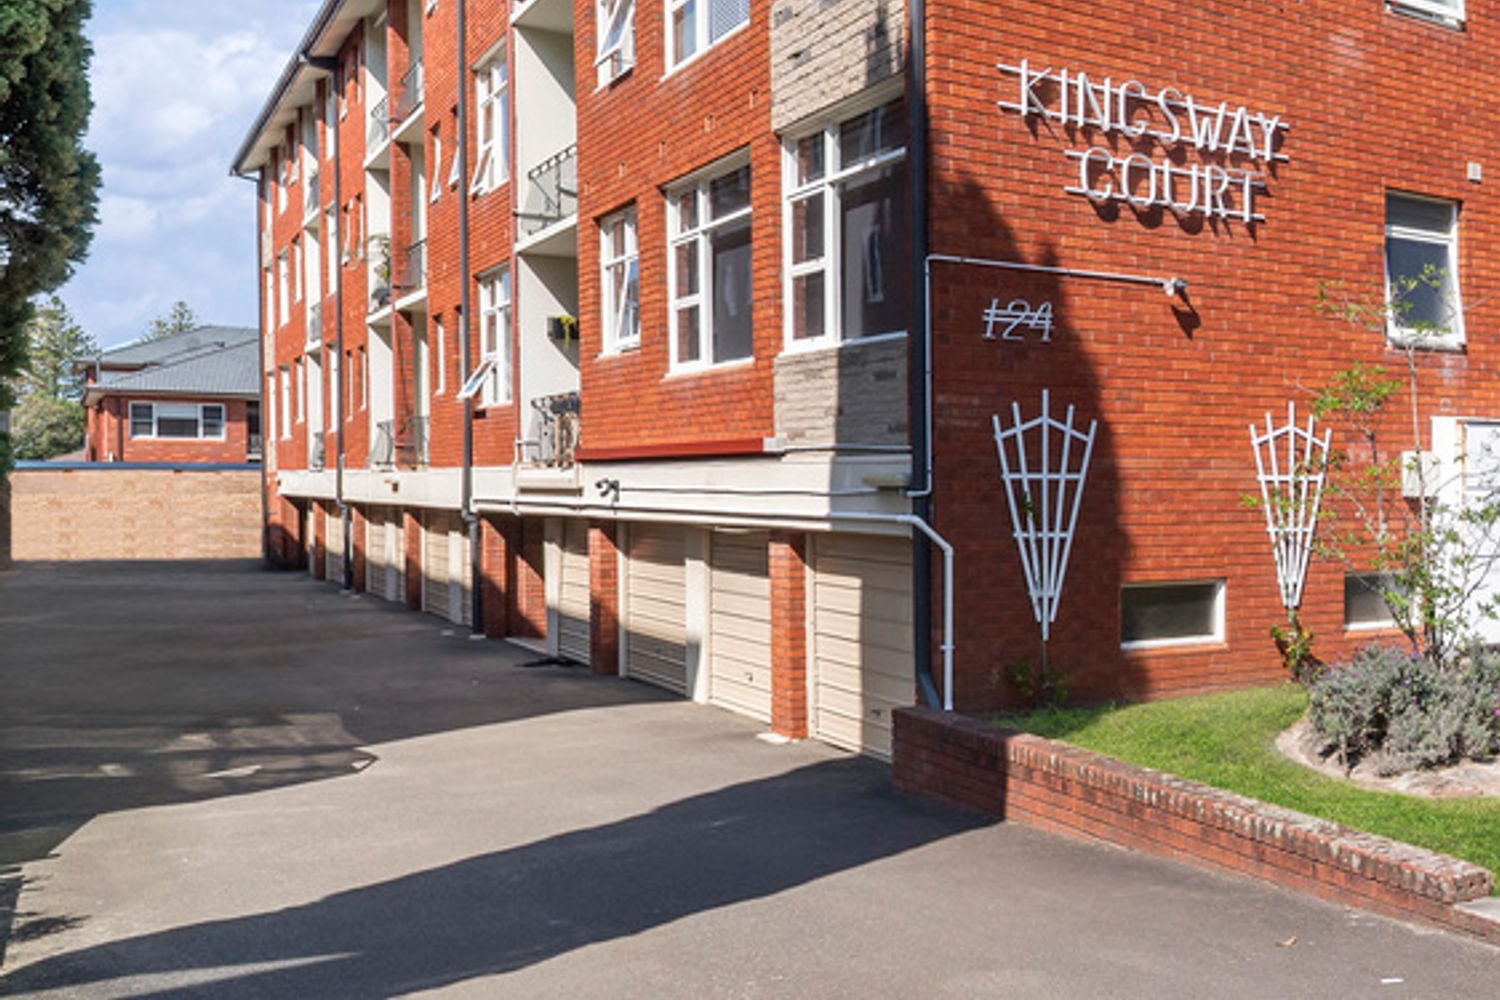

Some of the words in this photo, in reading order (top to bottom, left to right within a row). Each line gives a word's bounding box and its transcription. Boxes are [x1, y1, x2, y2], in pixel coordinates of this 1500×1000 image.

[1019, 58, 1281, 162] KINGSWAY
[1080, 146, 1266, 223] COURT
[982, 298, 1053, 342] 124
